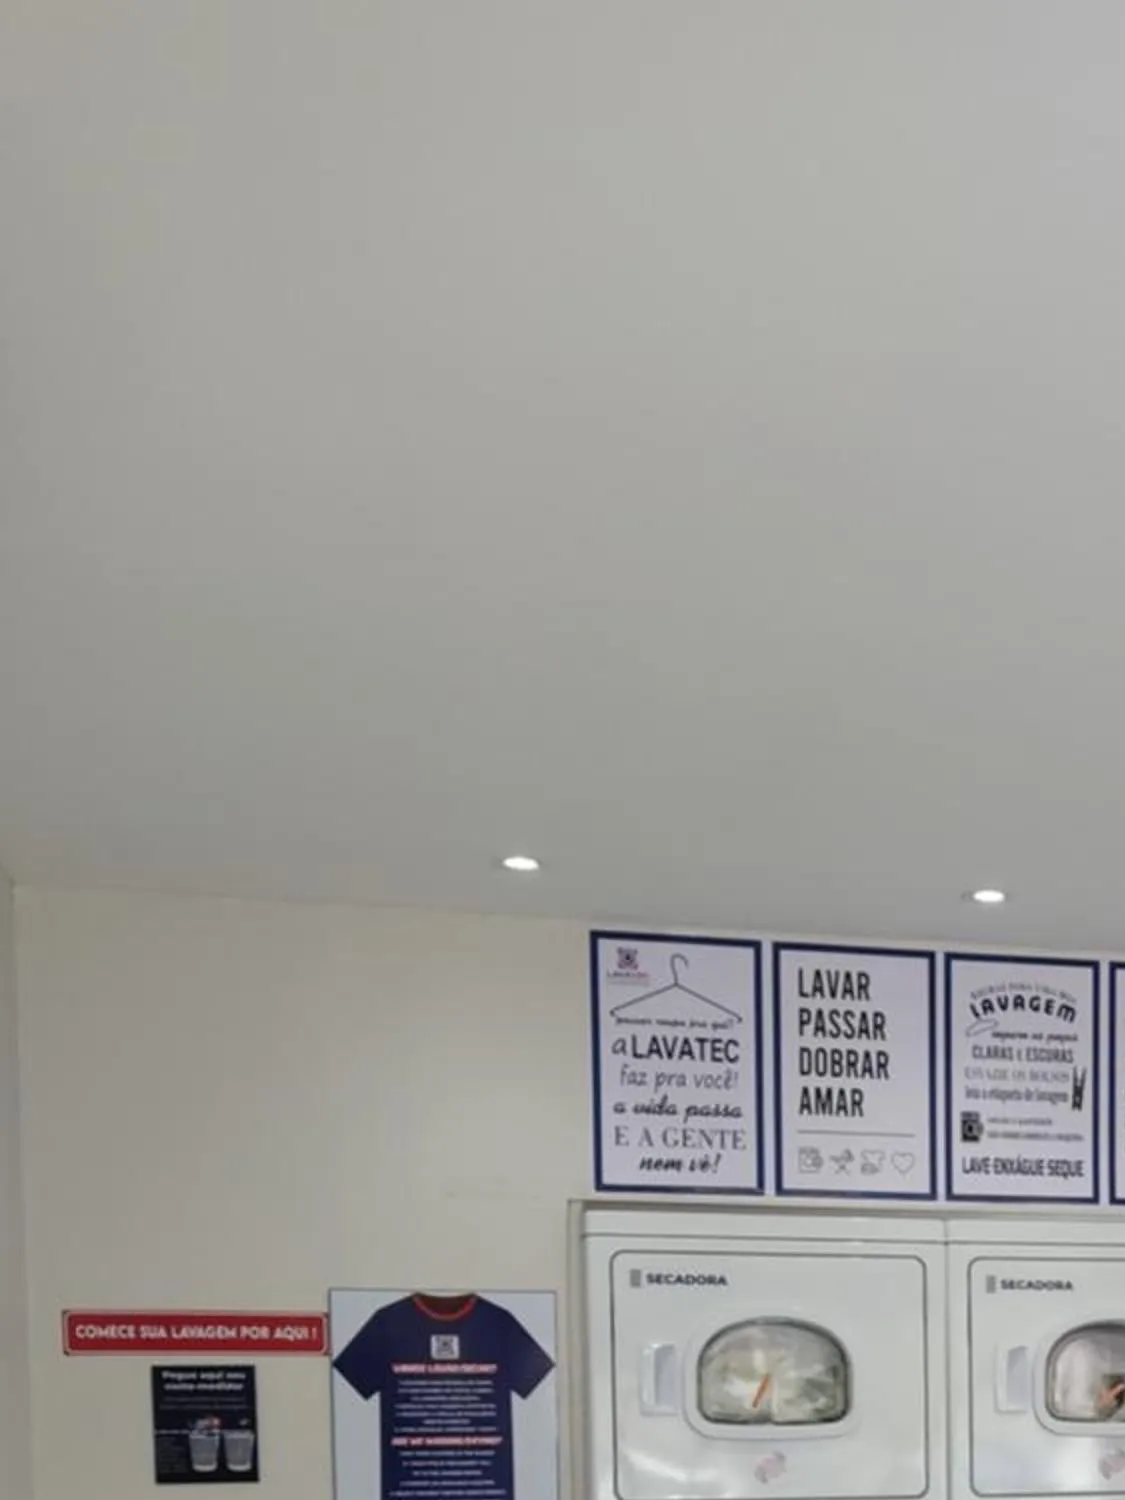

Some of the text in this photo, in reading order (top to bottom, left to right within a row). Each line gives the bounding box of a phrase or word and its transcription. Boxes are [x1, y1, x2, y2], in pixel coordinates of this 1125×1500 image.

[797, 967, 871, 1002] LAVAR
[969, 993, 1077, 1024] LAVAGEM
[798, 1008, 887, 1041] PASSAR
[612, 1034, 740, 1063] a LAVATEC
[972, 1044, 1014, 1062] CLARAS
[1026, 1047, 1074, 1064] ESCURAS
[799, 1047, 890, 1080] DOBRAR
[620, 1064, 739, 1093] faz pra você!
[613, 1095, 742, 1124] a vida passa
[798, 1086, 864, 1118] AMAR
[614, 1125, 747, 1150] E A GENTE
[639, 1155, 682, 1172] nem
[962, 1157, 990, 1175] LAVE
[1047, 1158, 1084, 1179] SEQUE
[645, 1272, 729, 1286] SECADORA
[1000, 1278, 1073, 1291] SECADORA
[76, 1324, 136, 1340] COMECE
[139, 1324, 166, 1340] SUA
[170, 1324, 236, 1340] LAVAGEM
[239, 1325, 269, 1340] POR
[273, 1325, 309, 1342] AQUI
